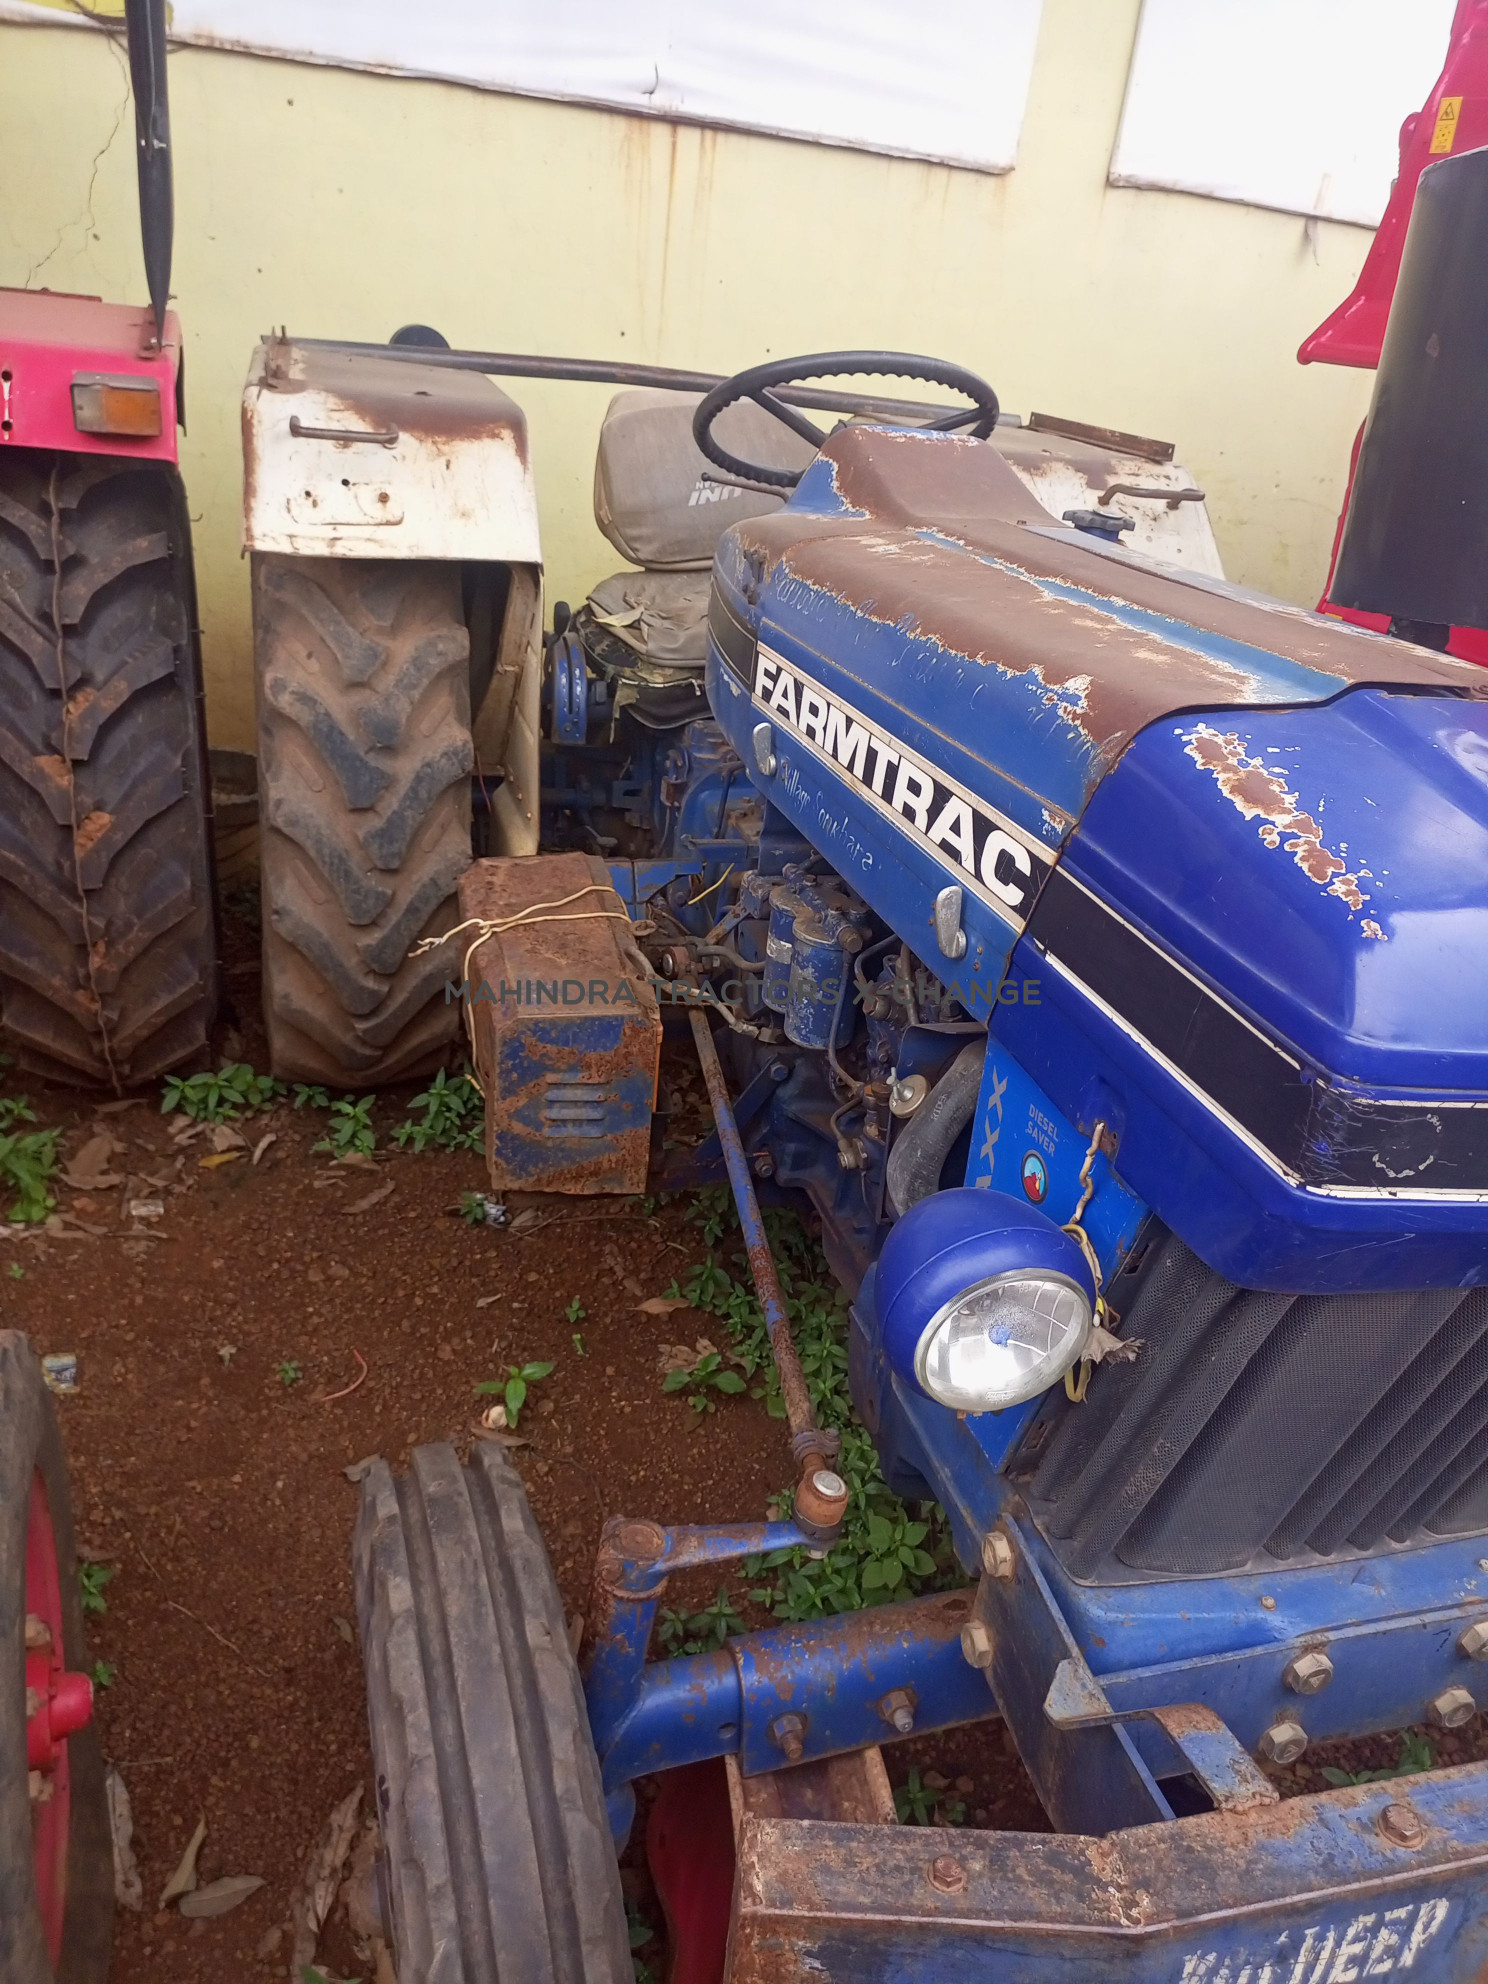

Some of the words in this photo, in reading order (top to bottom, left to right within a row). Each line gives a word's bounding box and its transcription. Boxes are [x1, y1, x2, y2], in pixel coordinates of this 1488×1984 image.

[755, 653, 1031, 906] FARMTRAC
[1027, 1121, 1055, 1157] SAVER
[1029, 1103, 1058, 1142] DIESEL
